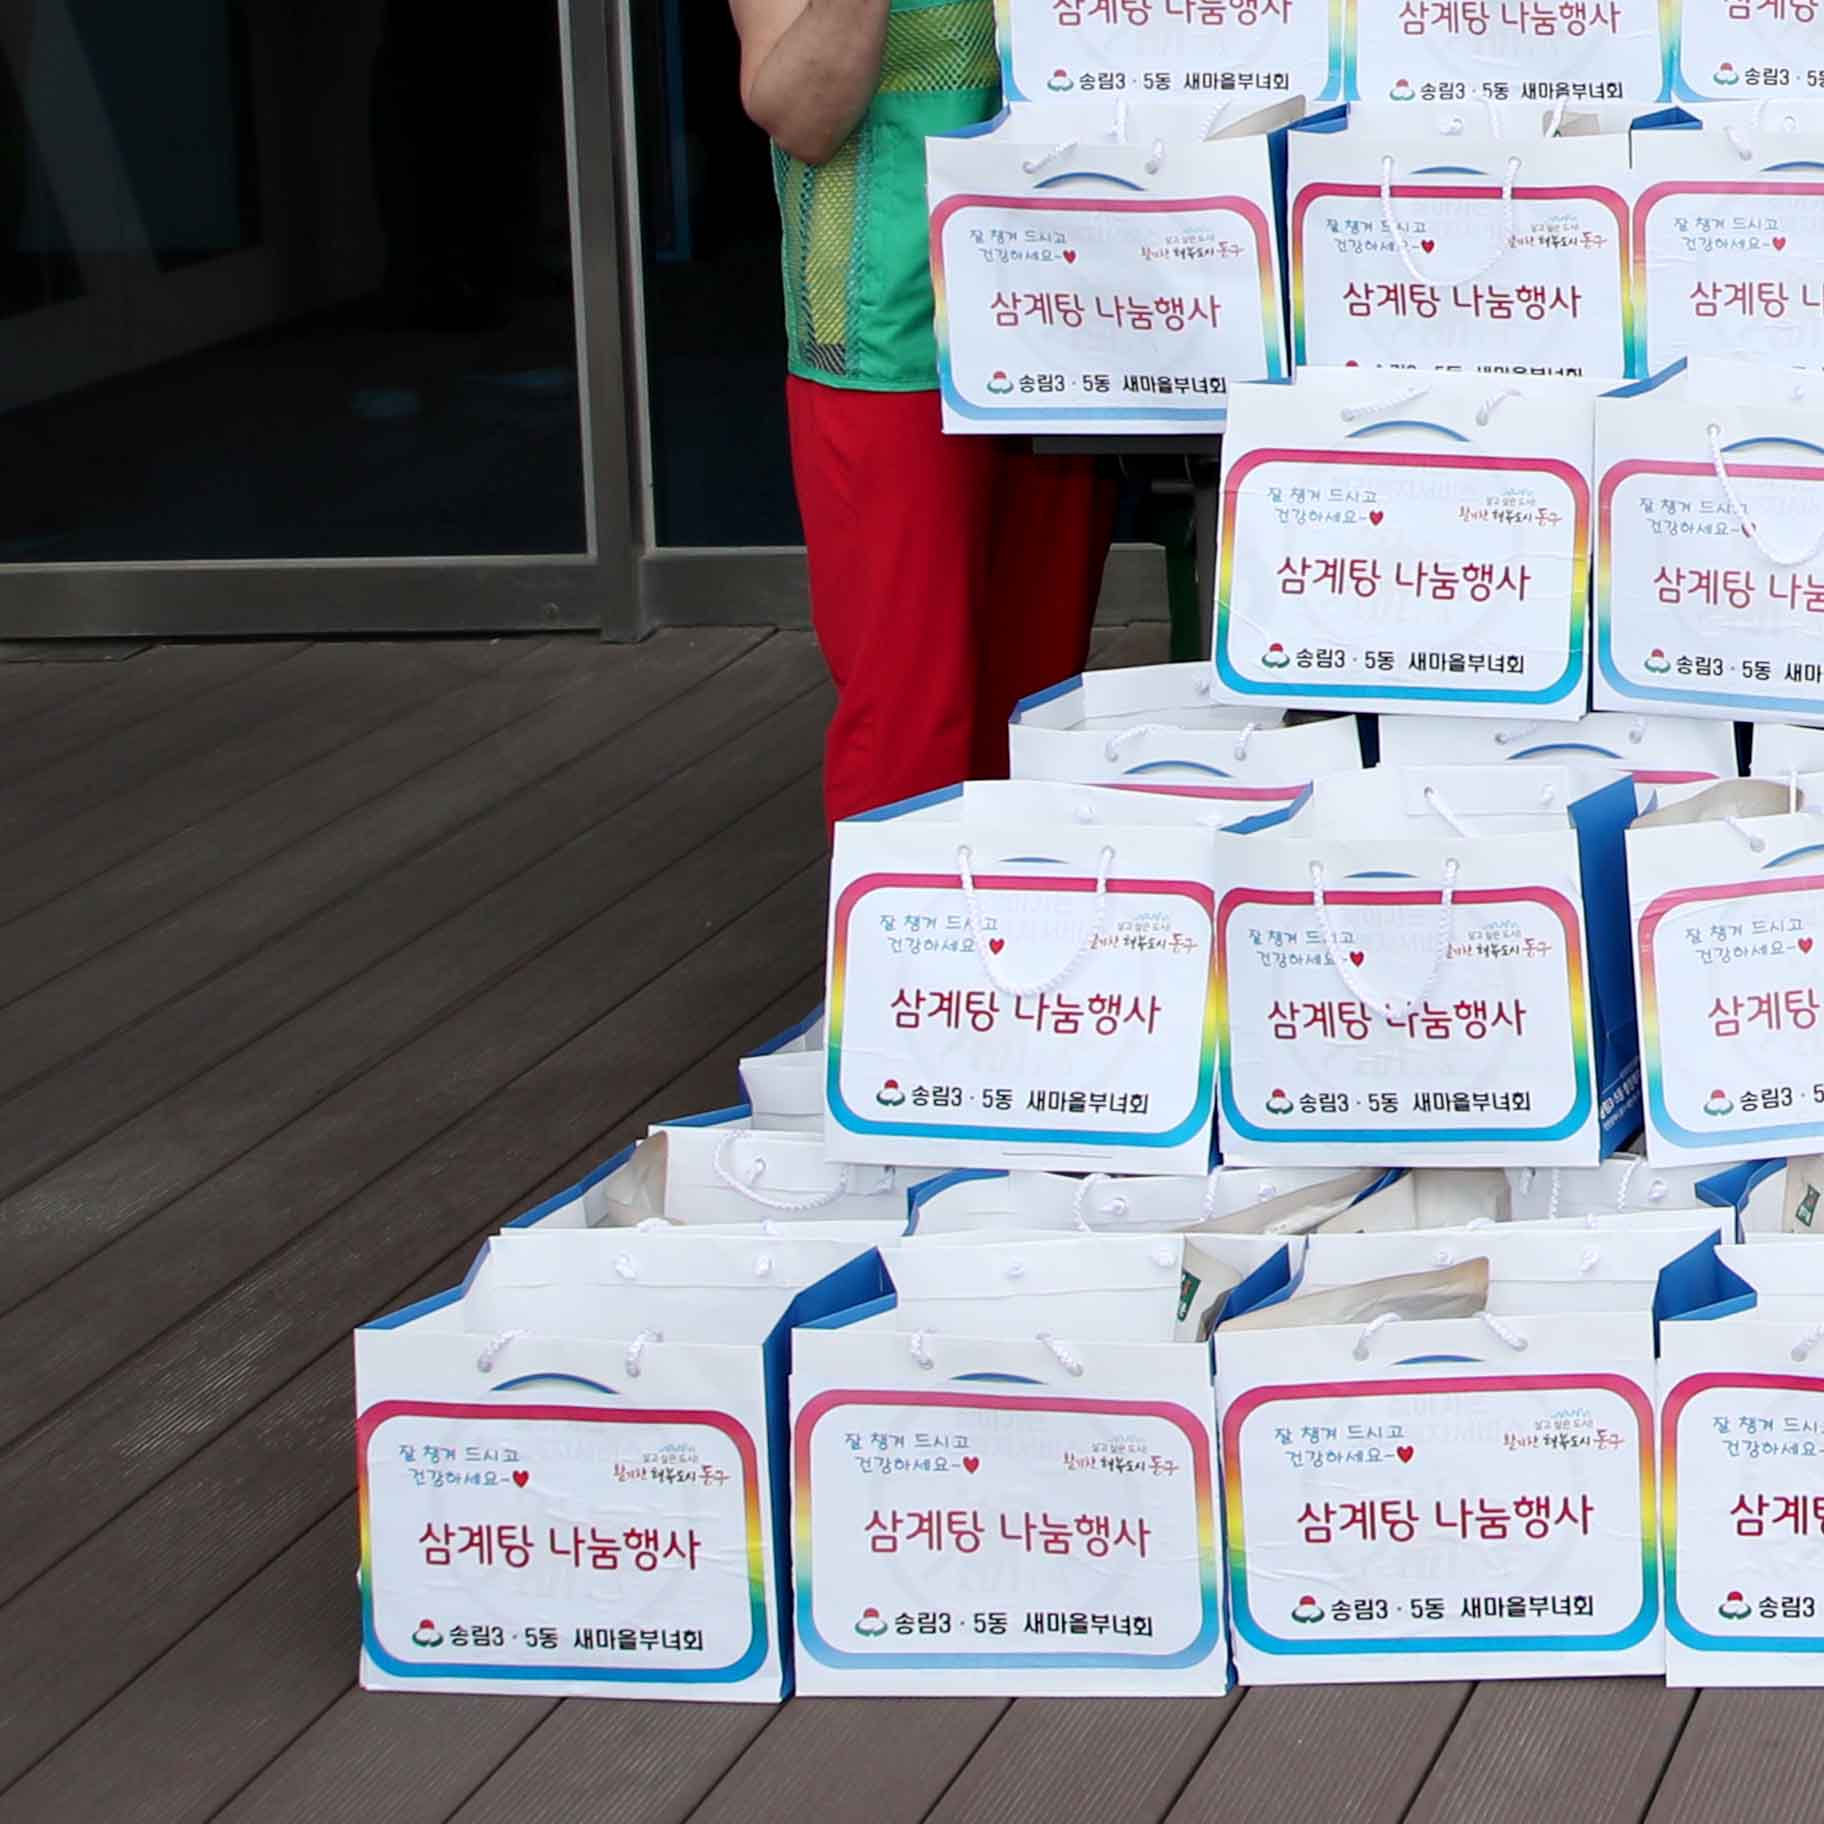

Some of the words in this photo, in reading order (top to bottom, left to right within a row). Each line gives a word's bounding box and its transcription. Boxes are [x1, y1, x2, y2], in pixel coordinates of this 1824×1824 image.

[1400, 1, 1490, 35] 삼계탕
[1502, 1, 1621, 36] 나눔행사
[991, 292, 1085, 328] 삼계탕
[1096, 296, 1221, 331] 나눔행사
[1343, 282, 1440, 318] 삼계탕
[1453, 285, 1581, 320] 나눔행사
[1690, 281, 1789, 318] 삼계탕
[1123, 376, 1226, 394] 새마을부녀회
[1277, 557, 1381, 597] 삼계탕
[1396, 561, 1531, 602] 나눔행사
[1654, 566, 1755, 608] 삼계탕
[1409, 652, 1523, 674] 새마을부녀회
[891, 989, 1000, 1032] 삼계탕
[1015, 992, 1161, 1035] 나눔행사
[1708, 988, 1820, 1037] 삼계탕
[400, 1445, 416, 1462] 잘
[465, 1447, 520, 1462] 드시고
[845, 1433, 862, 1450] 잘
[915, 1433, 970, 1448] 드시고
[865, 1510, 984, 1553] 삼계탕
[1000, 1512, 1151, 1558] 나눔행사
[1297, 1500, 1419, 1543] 삼계탕
[1436, 1494, 1594, 1539] 나눔행사
[419, 1523, 534, 1568] 삼계탕
[550, 1526, 701, 1571] 나눔행사
[1461, 1596, 1593, 1618] 새마을부녀회
[574, 1629, 703, 1651] 새마을부녀회
